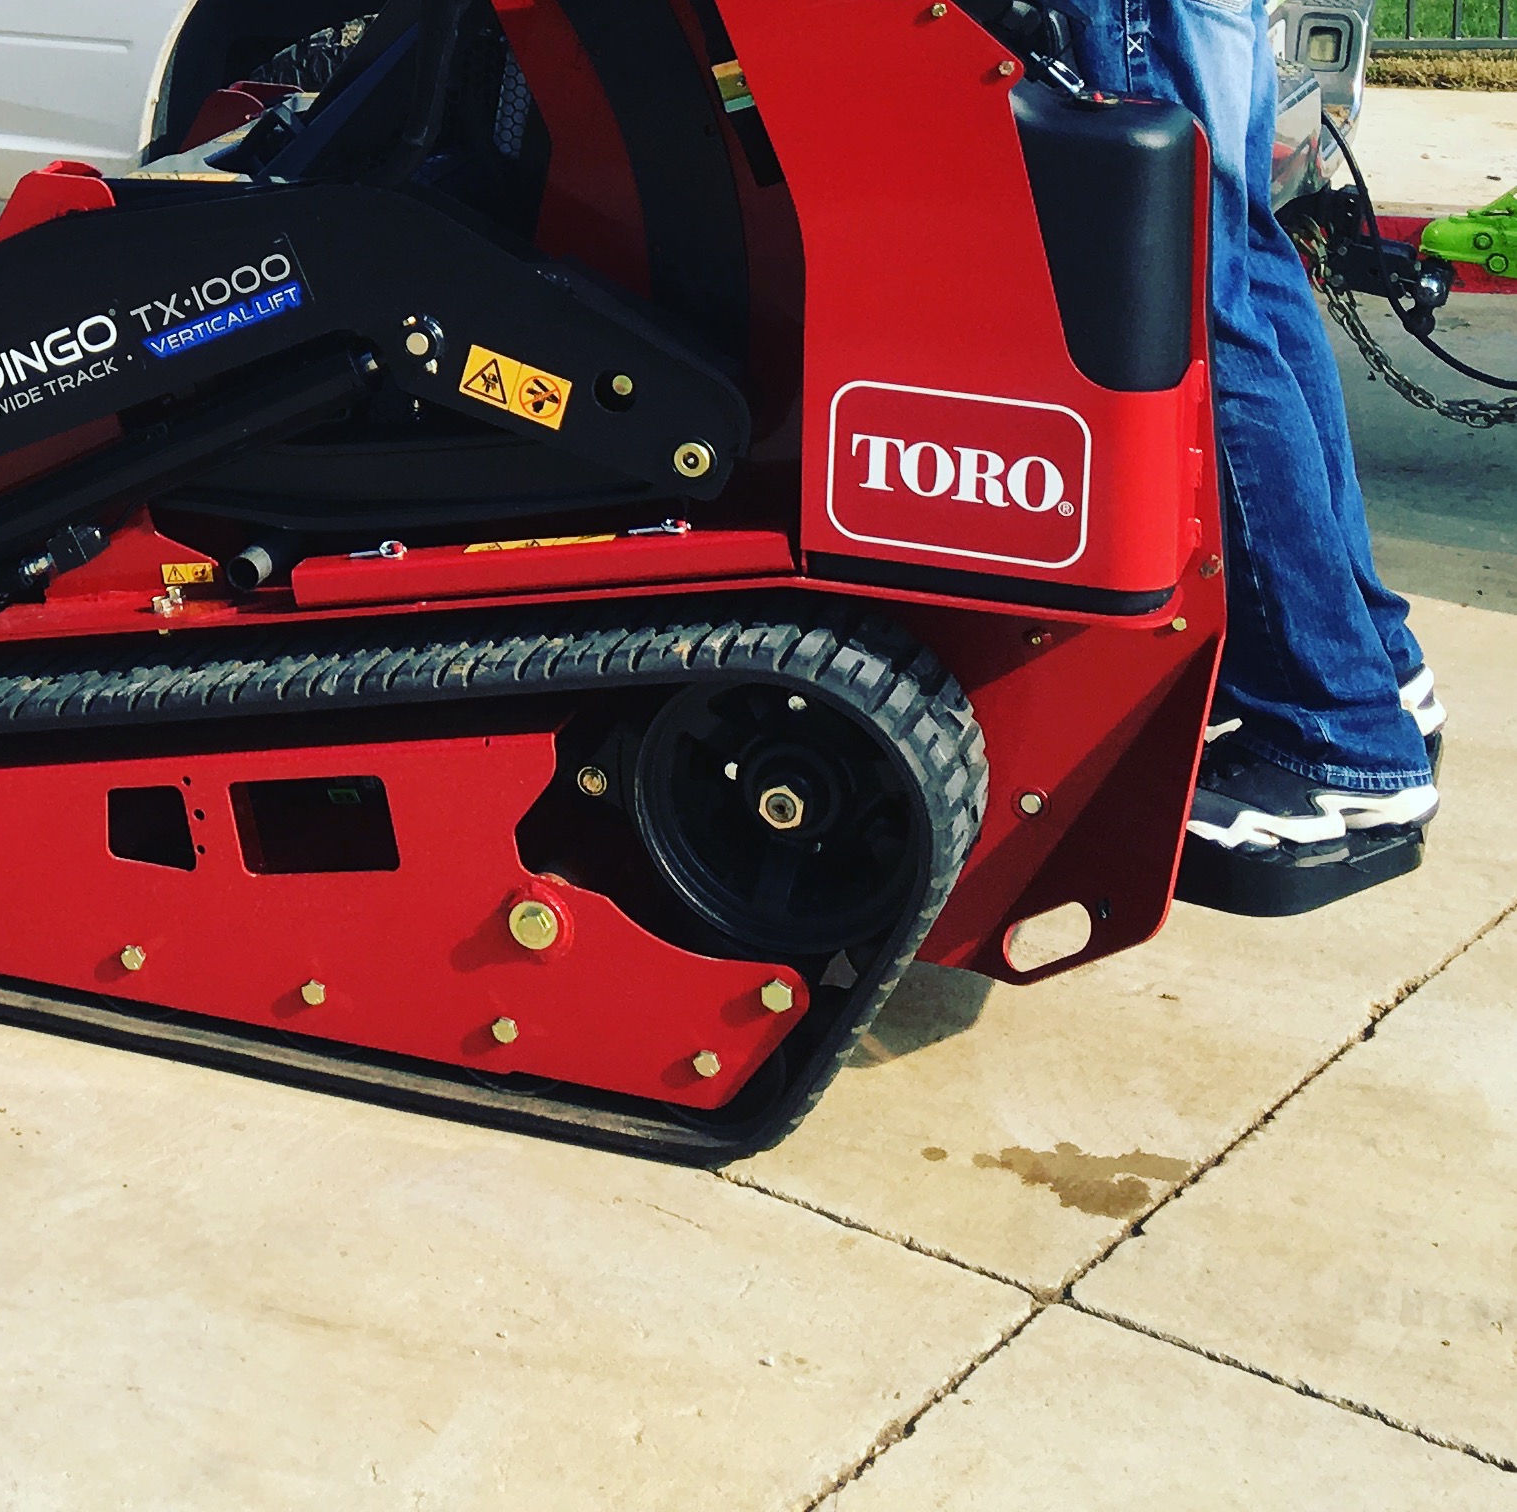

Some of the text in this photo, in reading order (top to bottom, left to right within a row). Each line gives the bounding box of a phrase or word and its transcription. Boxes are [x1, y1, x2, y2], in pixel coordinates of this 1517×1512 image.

[43, 356, 119, 398] TRACK
[150, 305, 256, 355] VERTICAL
[254, 285, 298, 316] LIFT
